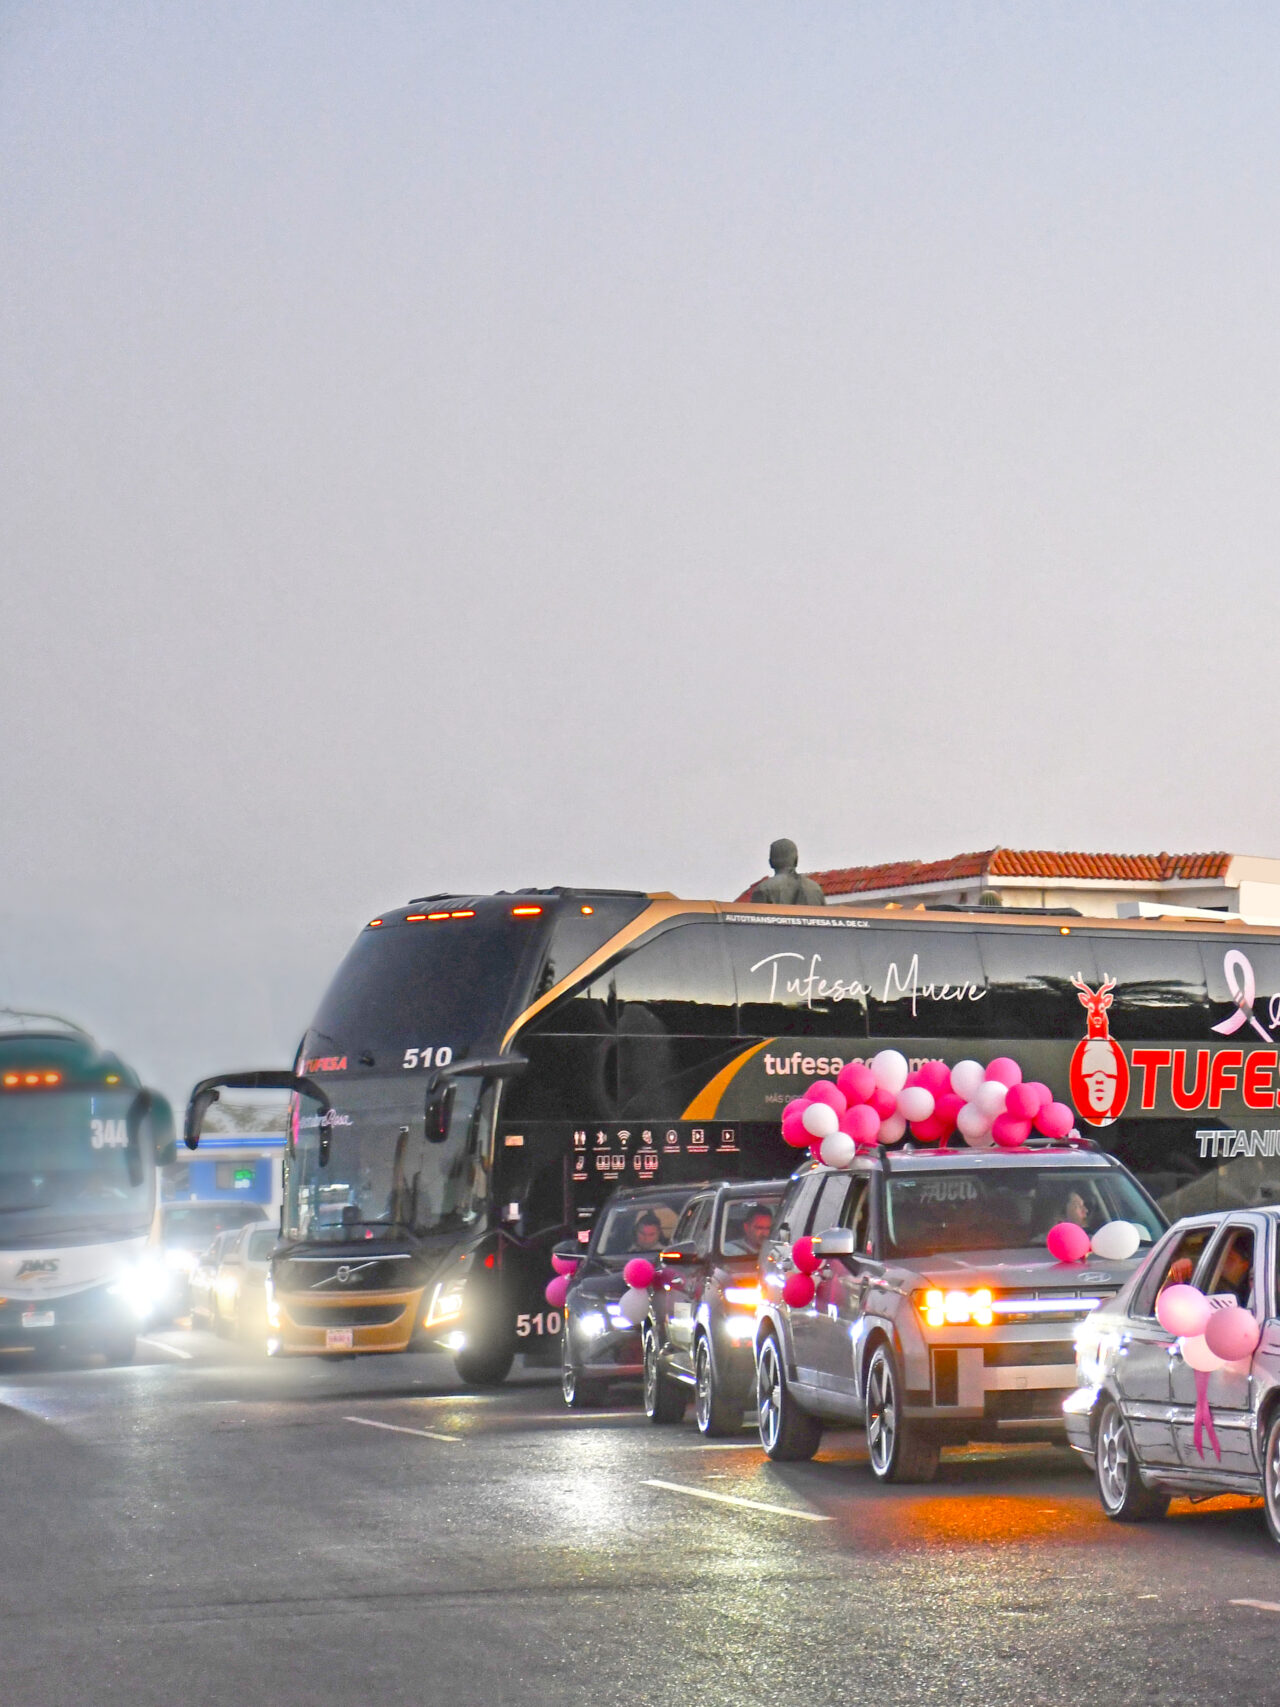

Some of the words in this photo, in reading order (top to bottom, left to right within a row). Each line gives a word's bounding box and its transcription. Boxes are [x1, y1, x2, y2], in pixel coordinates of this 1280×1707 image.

[725, 914, 801, 925] AUTOTRANSPORTES
[801, 918, 832, 927] TUFESA
[750, 953, 871, 1009] Tufesa
[883, 954, 986, 1016] Mueve
[305, 1056, 348, 1073] TUFESA
[402, 1046, 453, 1069] 510
[90, 1119, 130, 1149] 344
[515, 1311, 562, 1337] 510
